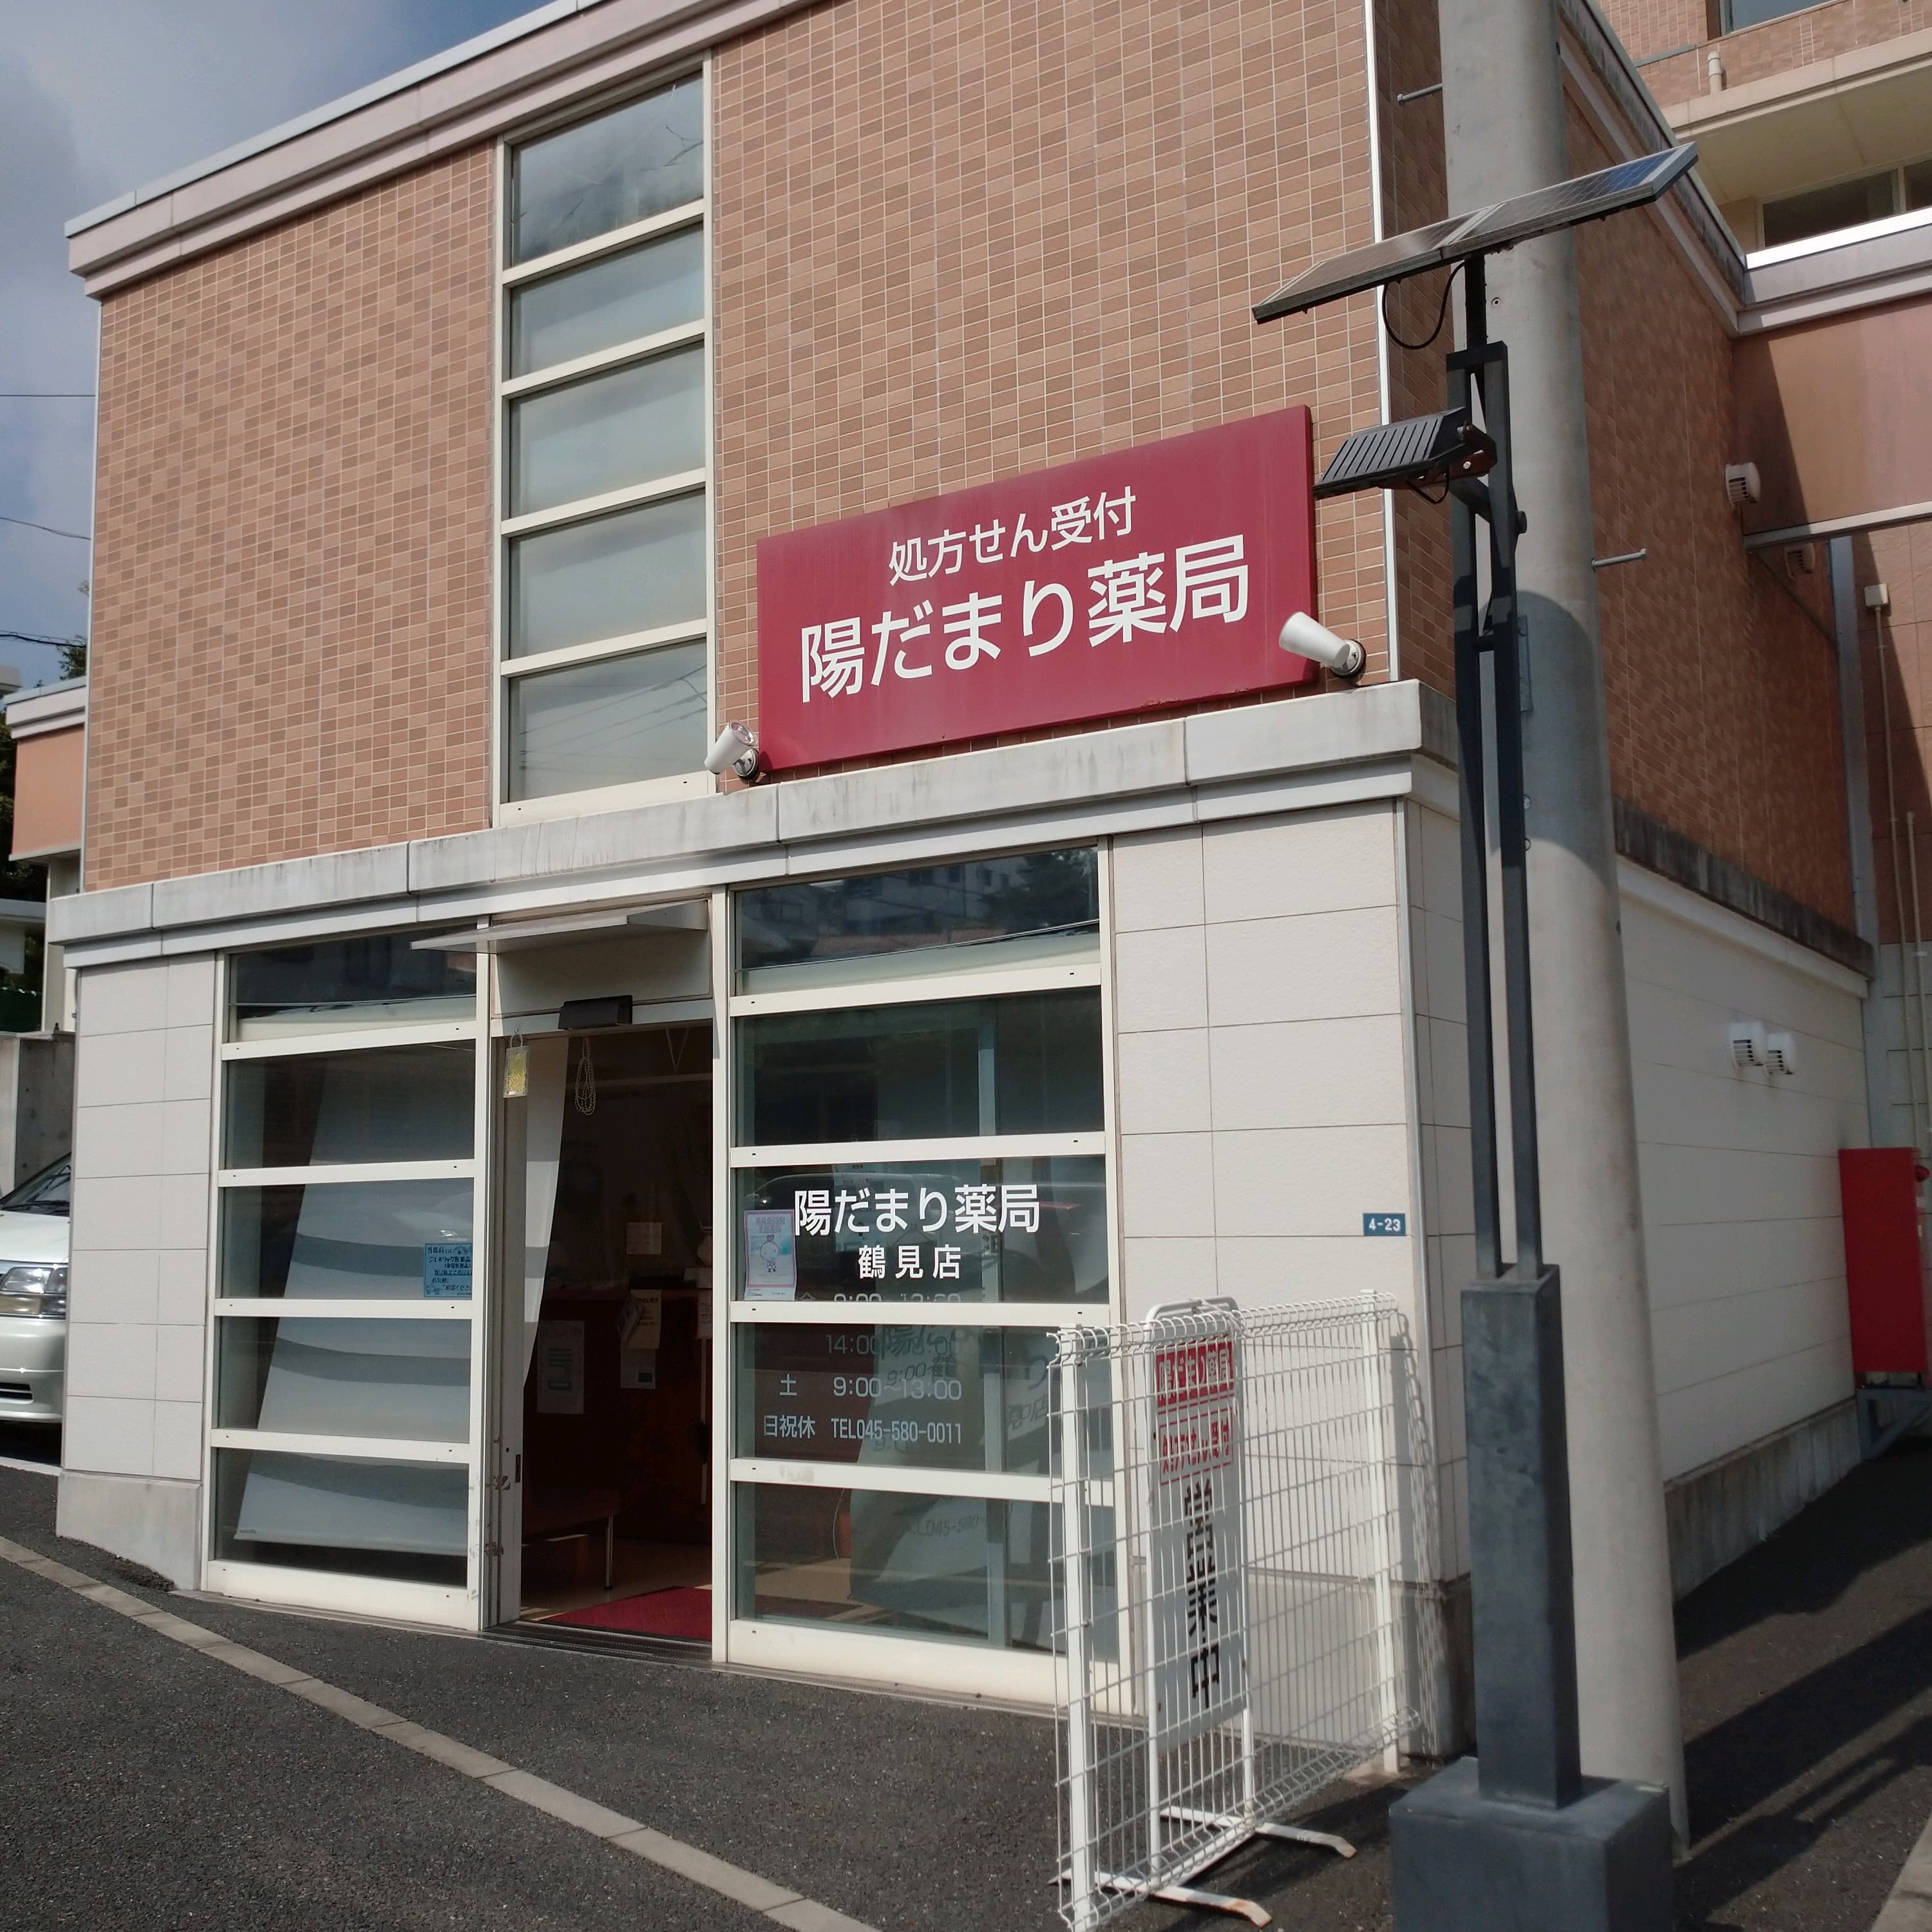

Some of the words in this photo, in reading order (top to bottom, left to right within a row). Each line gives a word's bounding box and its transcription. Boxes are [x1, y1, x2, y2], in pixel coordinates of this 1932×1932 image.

[888, 486, 1137, 586] 処方せん受付
[801, 534, 1249, 703] 陽だまり薬局
[794, 1184, 1039, 1236] 陽だまり薬局
[1368, 1217, 1401, 1231] 4-23
[858, 1244, 961, 1280] 鶴見店
[779, 1373, 797, 1396] 土
[763, 1414, 815, 1439] 日祝休
[831, 1417, 961, 1444] TEL045-580-0011
